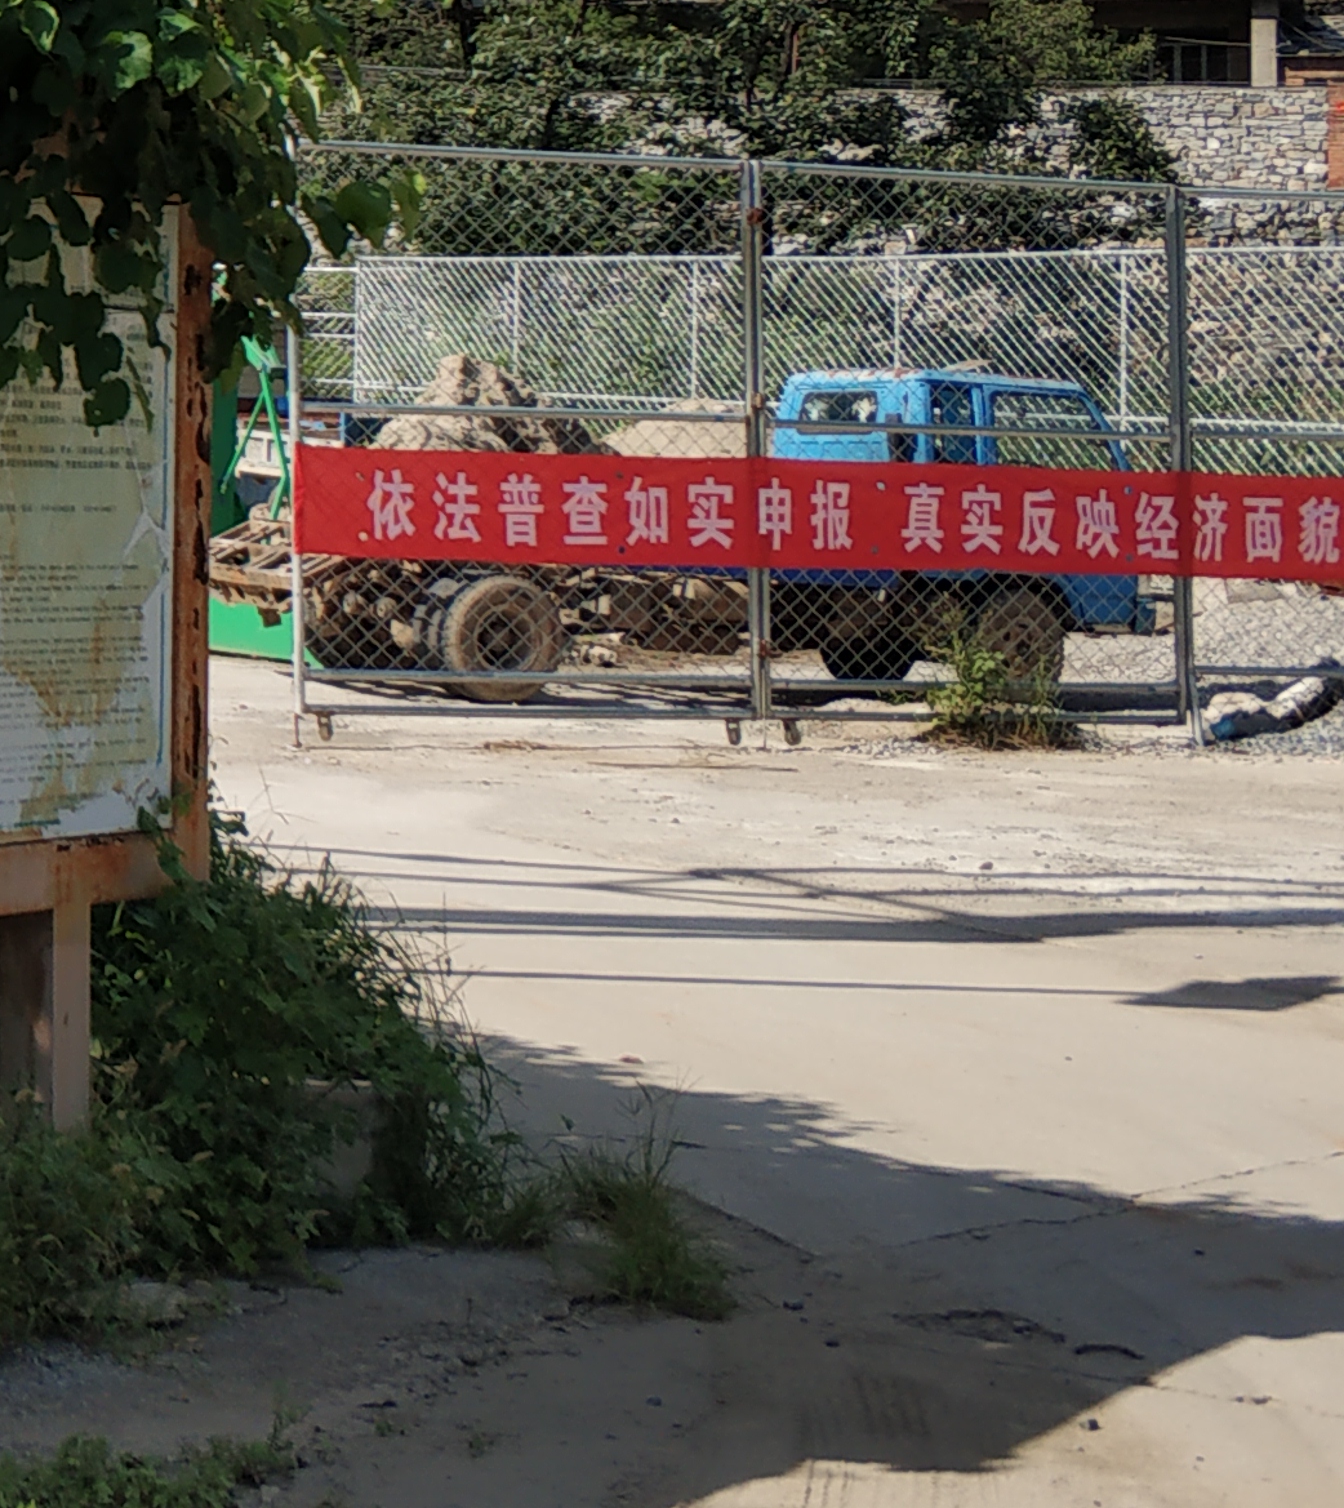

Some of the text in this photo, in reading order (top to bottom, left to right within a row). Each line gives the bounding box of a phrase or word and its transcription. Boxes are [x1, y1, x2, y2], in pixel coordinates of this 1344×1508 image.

[366, 468, 1341, 564] 依法普查如实申报 真实反映经济面貌
